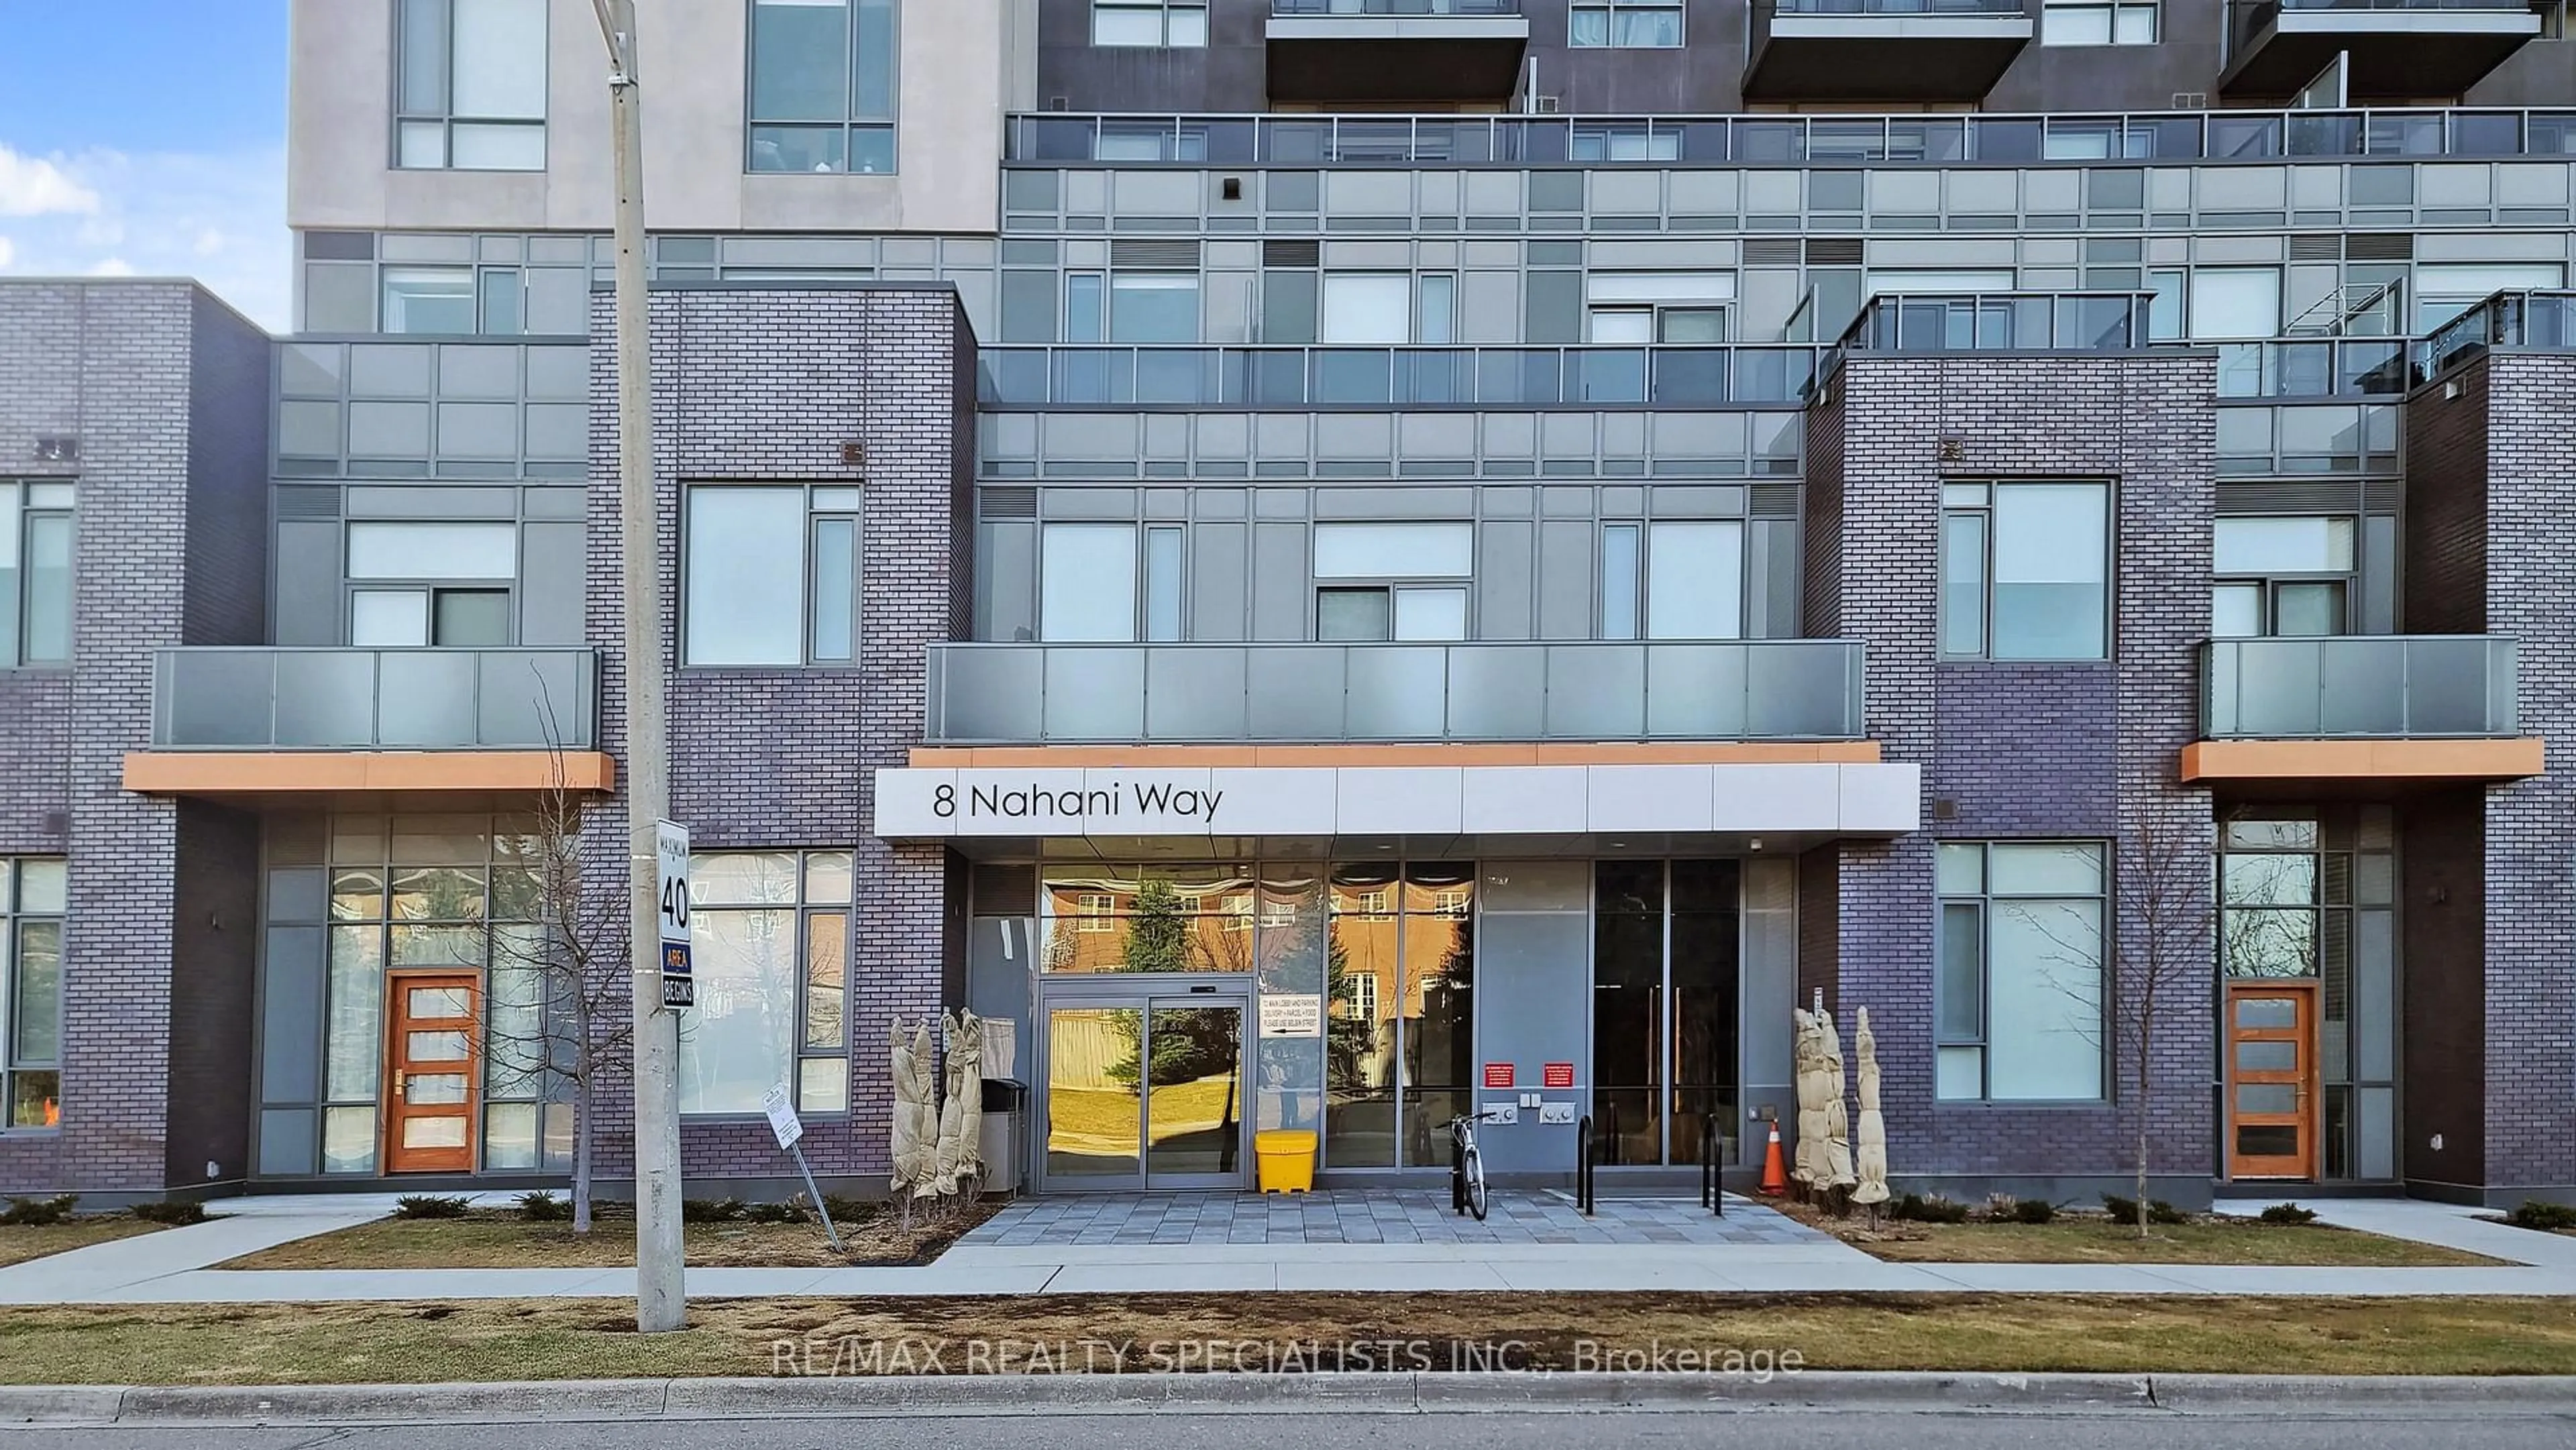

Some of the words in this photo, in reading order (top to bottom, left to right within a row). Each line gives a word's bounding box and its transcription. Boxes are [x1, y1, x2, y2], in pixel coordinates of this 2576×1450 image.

[933, 783, 955, 818] 8
[971, 781, 1120, 817] Nahani
[1134, 783, 1224, 823] Way
[660, 836, 686, 858] MAXIMUM
[661, 875, 688, 929] 40
[666, 948, 688, 967] AREA
[664, 980, 692, 1001] BEGINS
